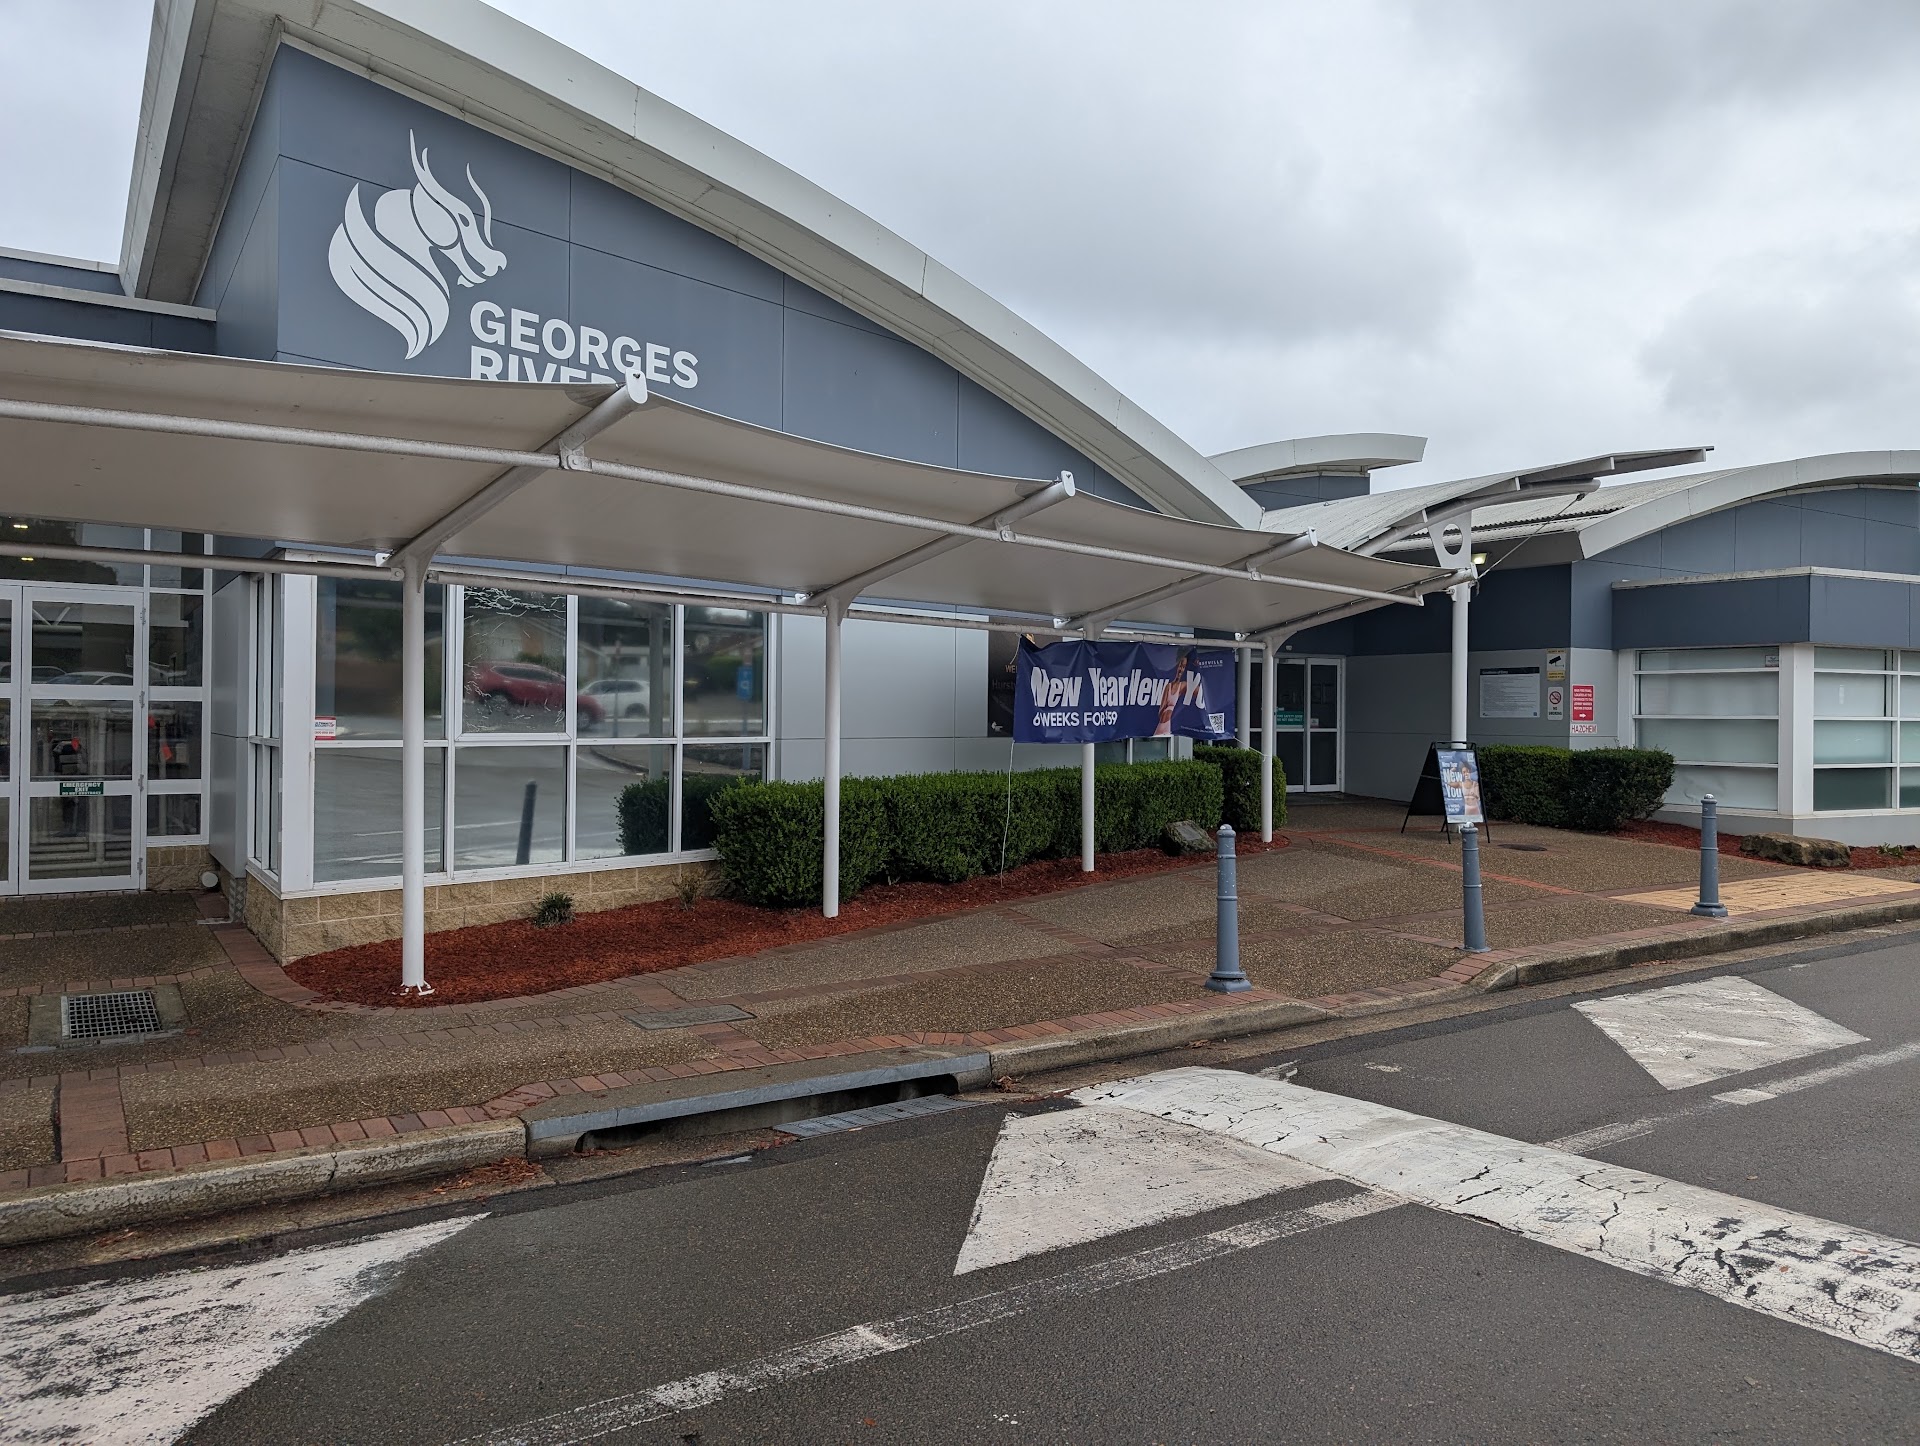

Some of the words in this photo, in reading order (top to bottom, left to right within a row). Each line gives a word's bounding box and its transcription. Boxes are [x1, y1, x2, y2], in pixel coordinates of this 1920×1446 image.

[470, 300, 699, 389] GEORGES
[470, 345, 618, 384] RIV
[1030, 666, 1083, 708] New
[1088, 667, 1127, 707] Year
[1126, 668, 1169, 707] New
[1182, 670, 1207, 710] Yo
[1083, 711, 1106, 727] FOR
[1571, 724, 1597, 734] HAZCHEM
[1442, 768, 1463, 783] New
